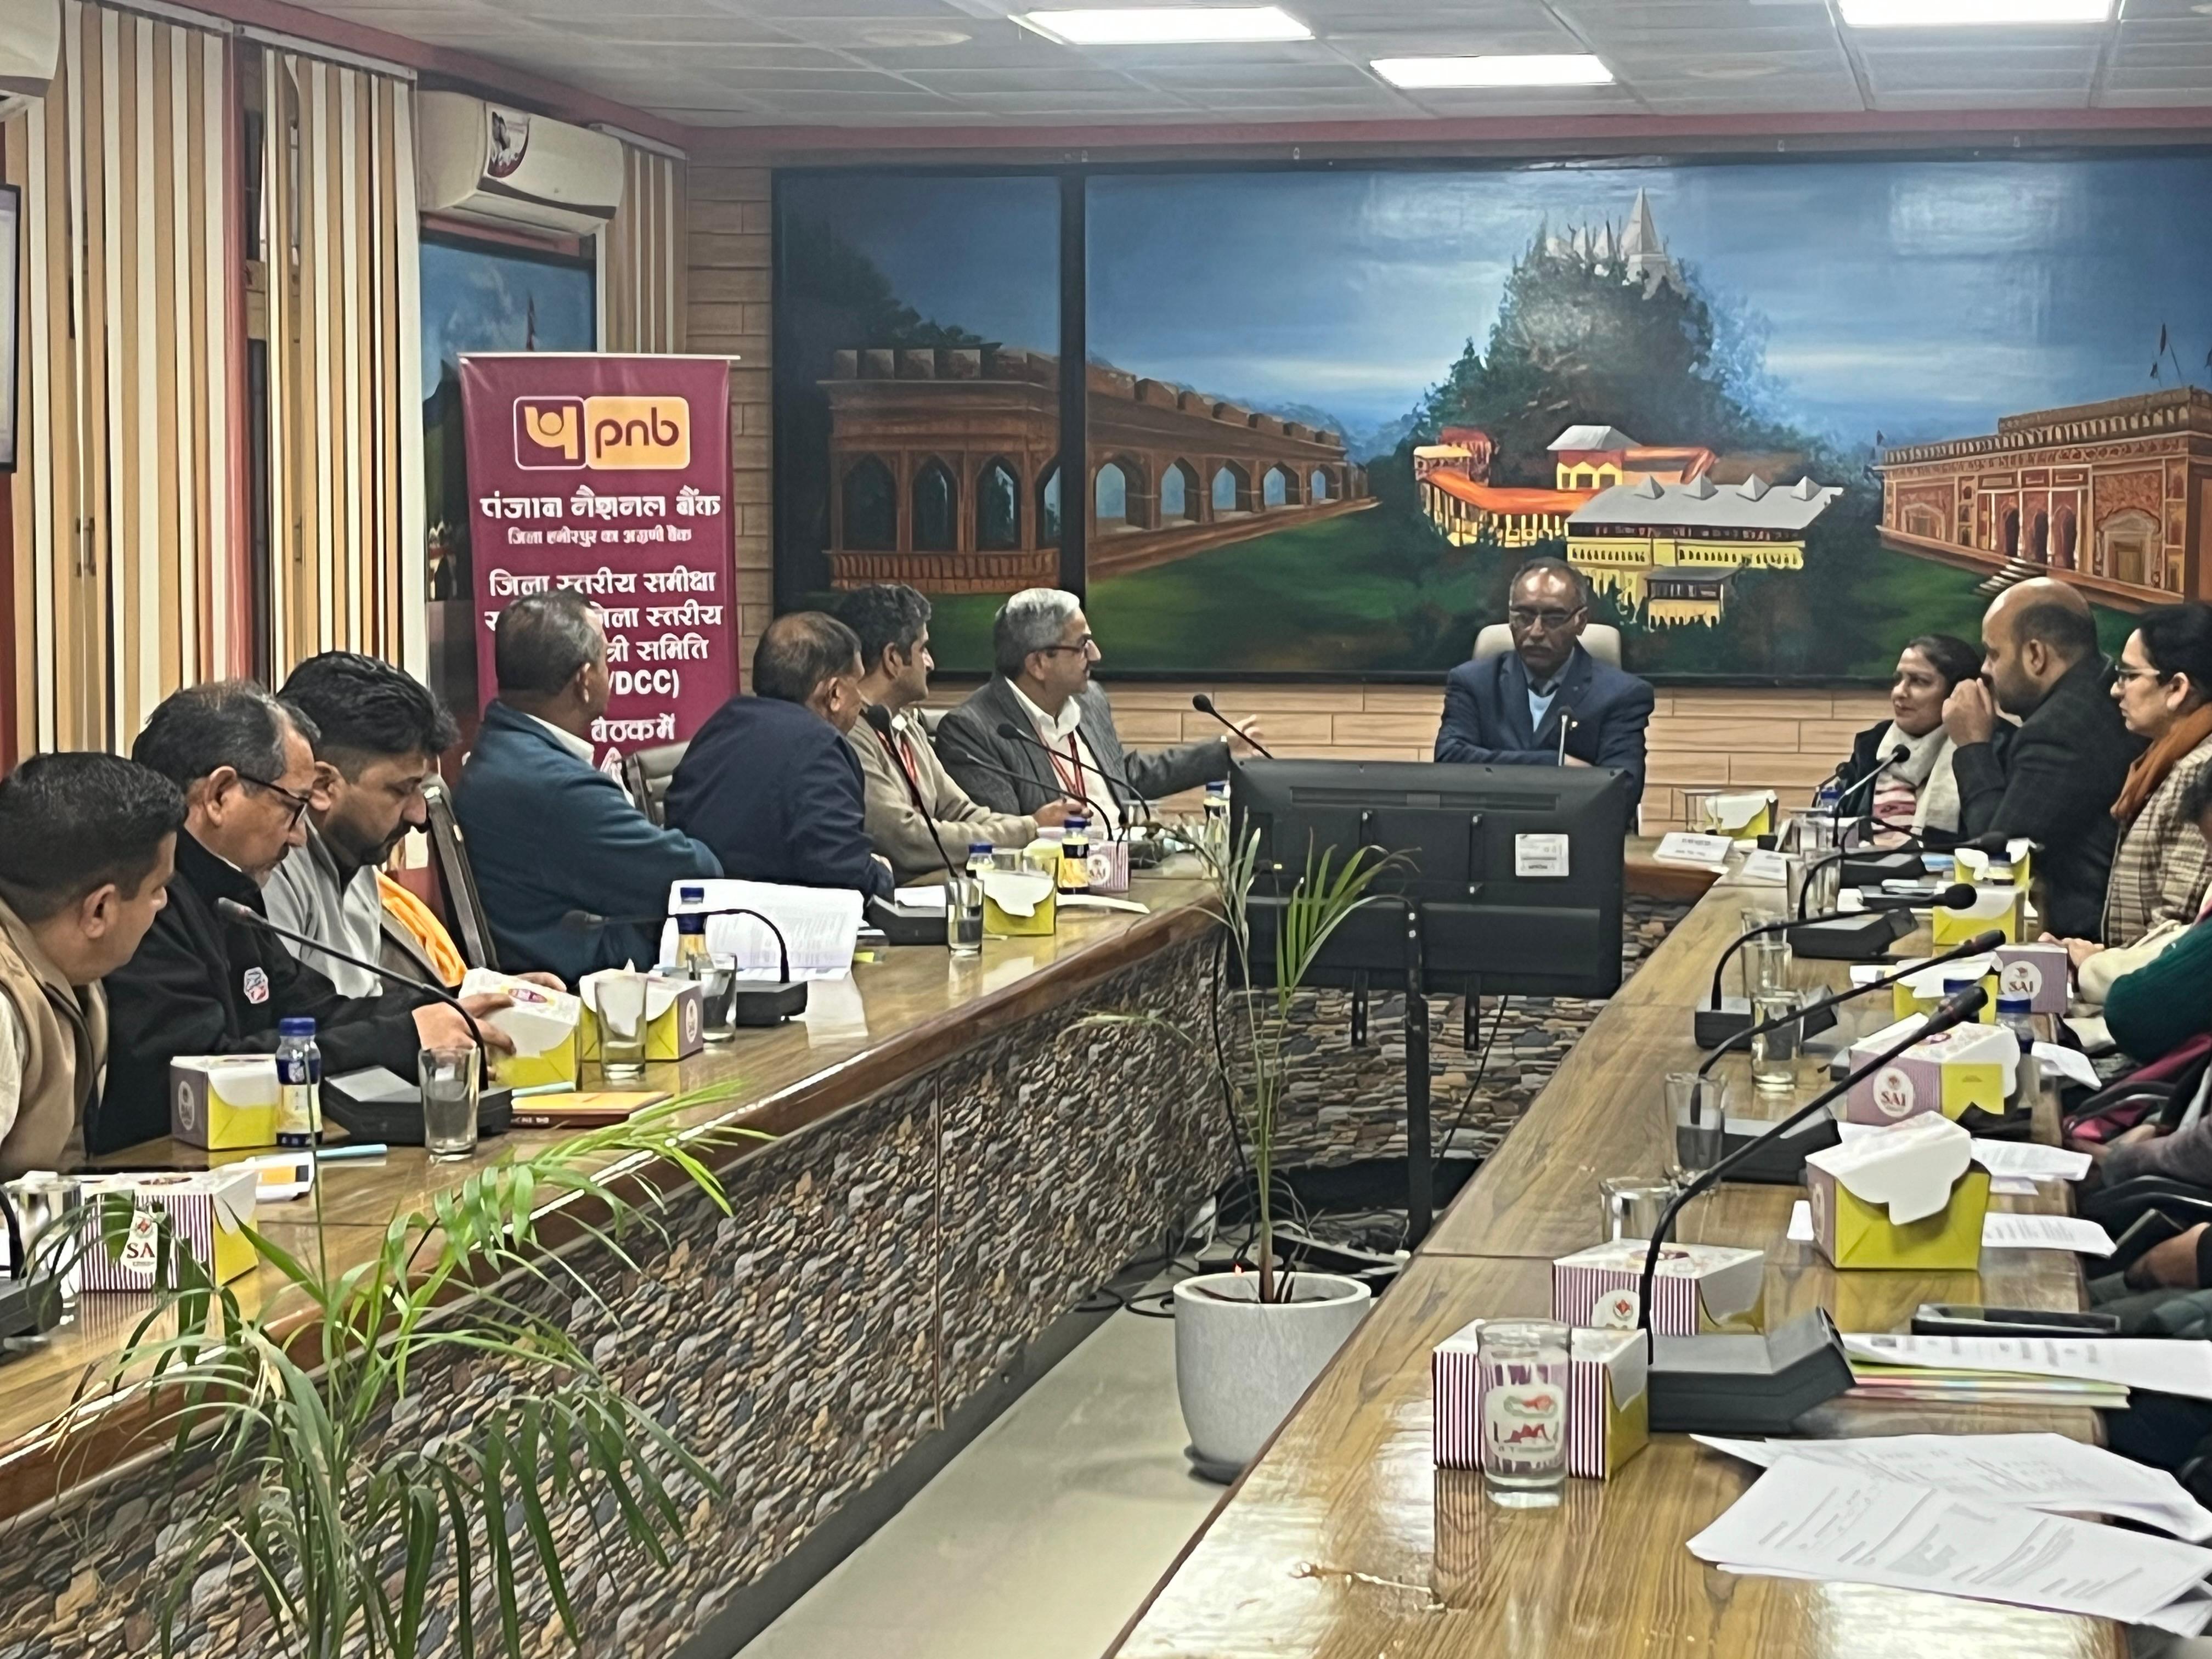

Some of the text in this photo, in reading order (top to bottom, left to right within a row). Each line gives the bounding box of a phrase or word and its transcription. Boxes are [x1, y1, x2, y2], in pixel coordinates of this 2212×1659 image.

[595, 407, 679, 459] pnb
[480, 490, 563, 519] पंजाब
[676, 485, 721, 517] बैंक
[508, 526, 543, 544] जिला
[489, 565, 716, 596] जिला स्तरीय समीक्षा
[646, 599, 724, 627] स्तरीय
[636, 633, 709, 661] समिति
[608, 669, 680, 699] /DCC)
[126, 1242, 155, 1259] SA
